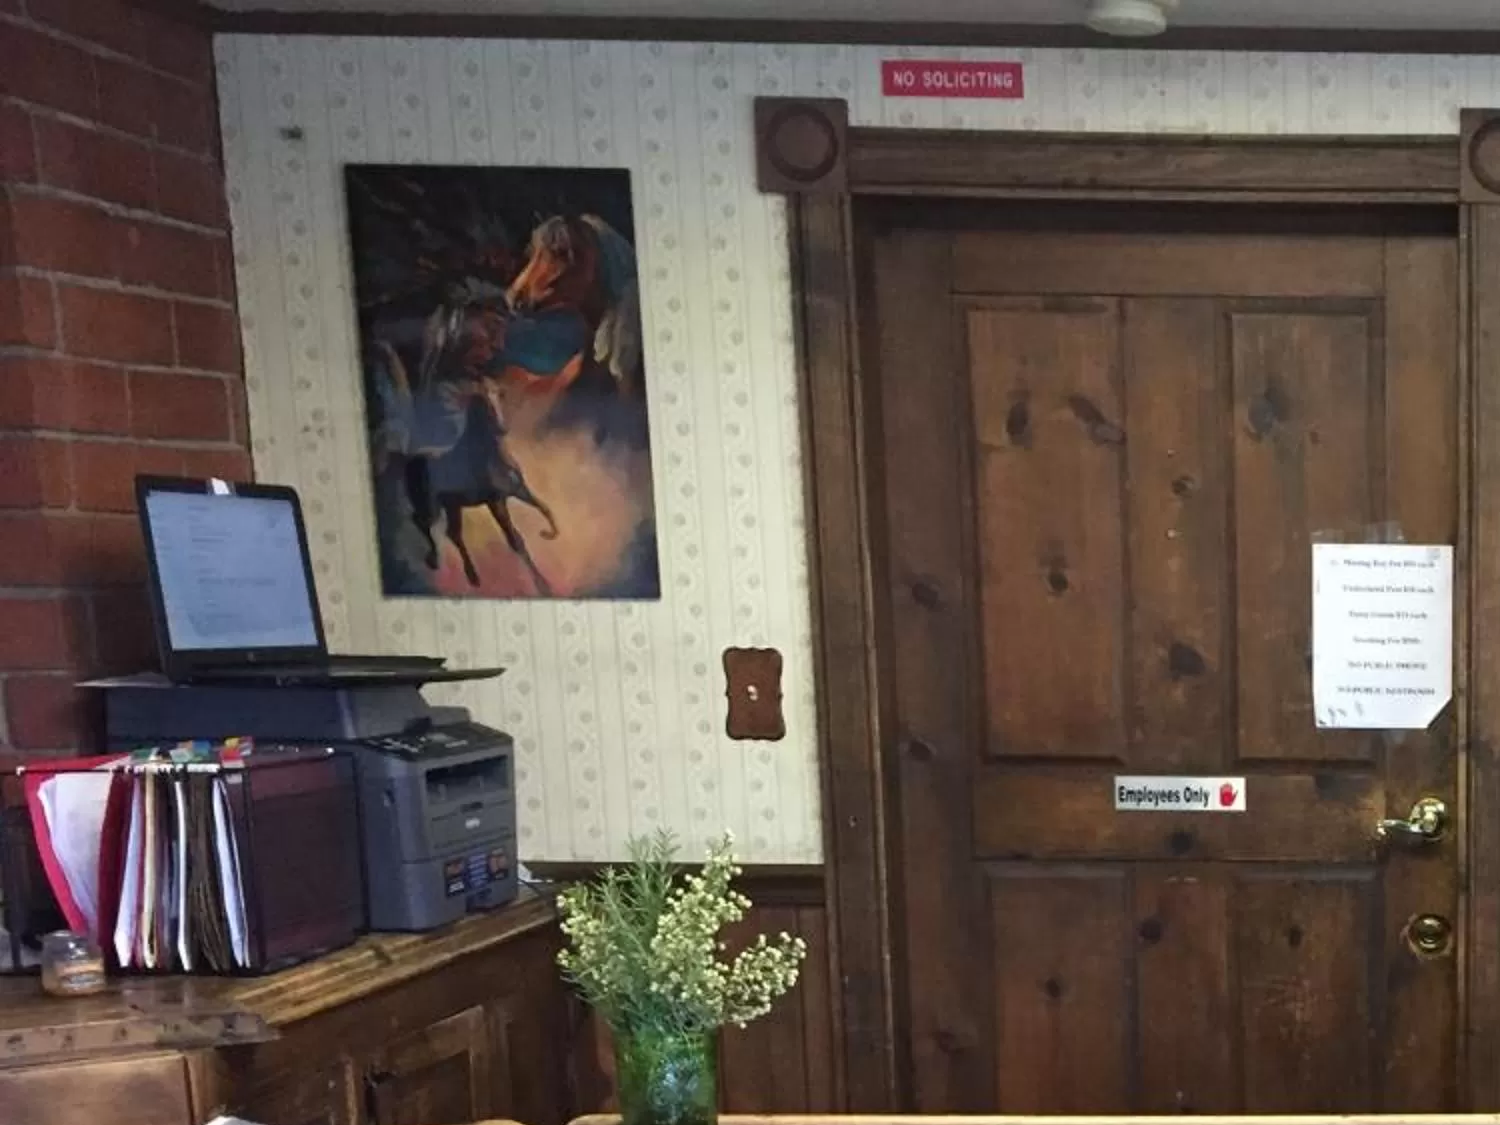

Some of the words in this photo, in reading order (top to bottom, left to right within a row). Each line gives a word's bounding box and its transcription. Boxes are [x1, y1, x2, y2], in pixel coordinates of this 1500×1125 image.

[893, 71, 915, 87] NO
[923, 71, 1013, 88] SOLICITING
[1118, 785, 1180, 807] Employees
[1183, 786, 1210, 808] Only
